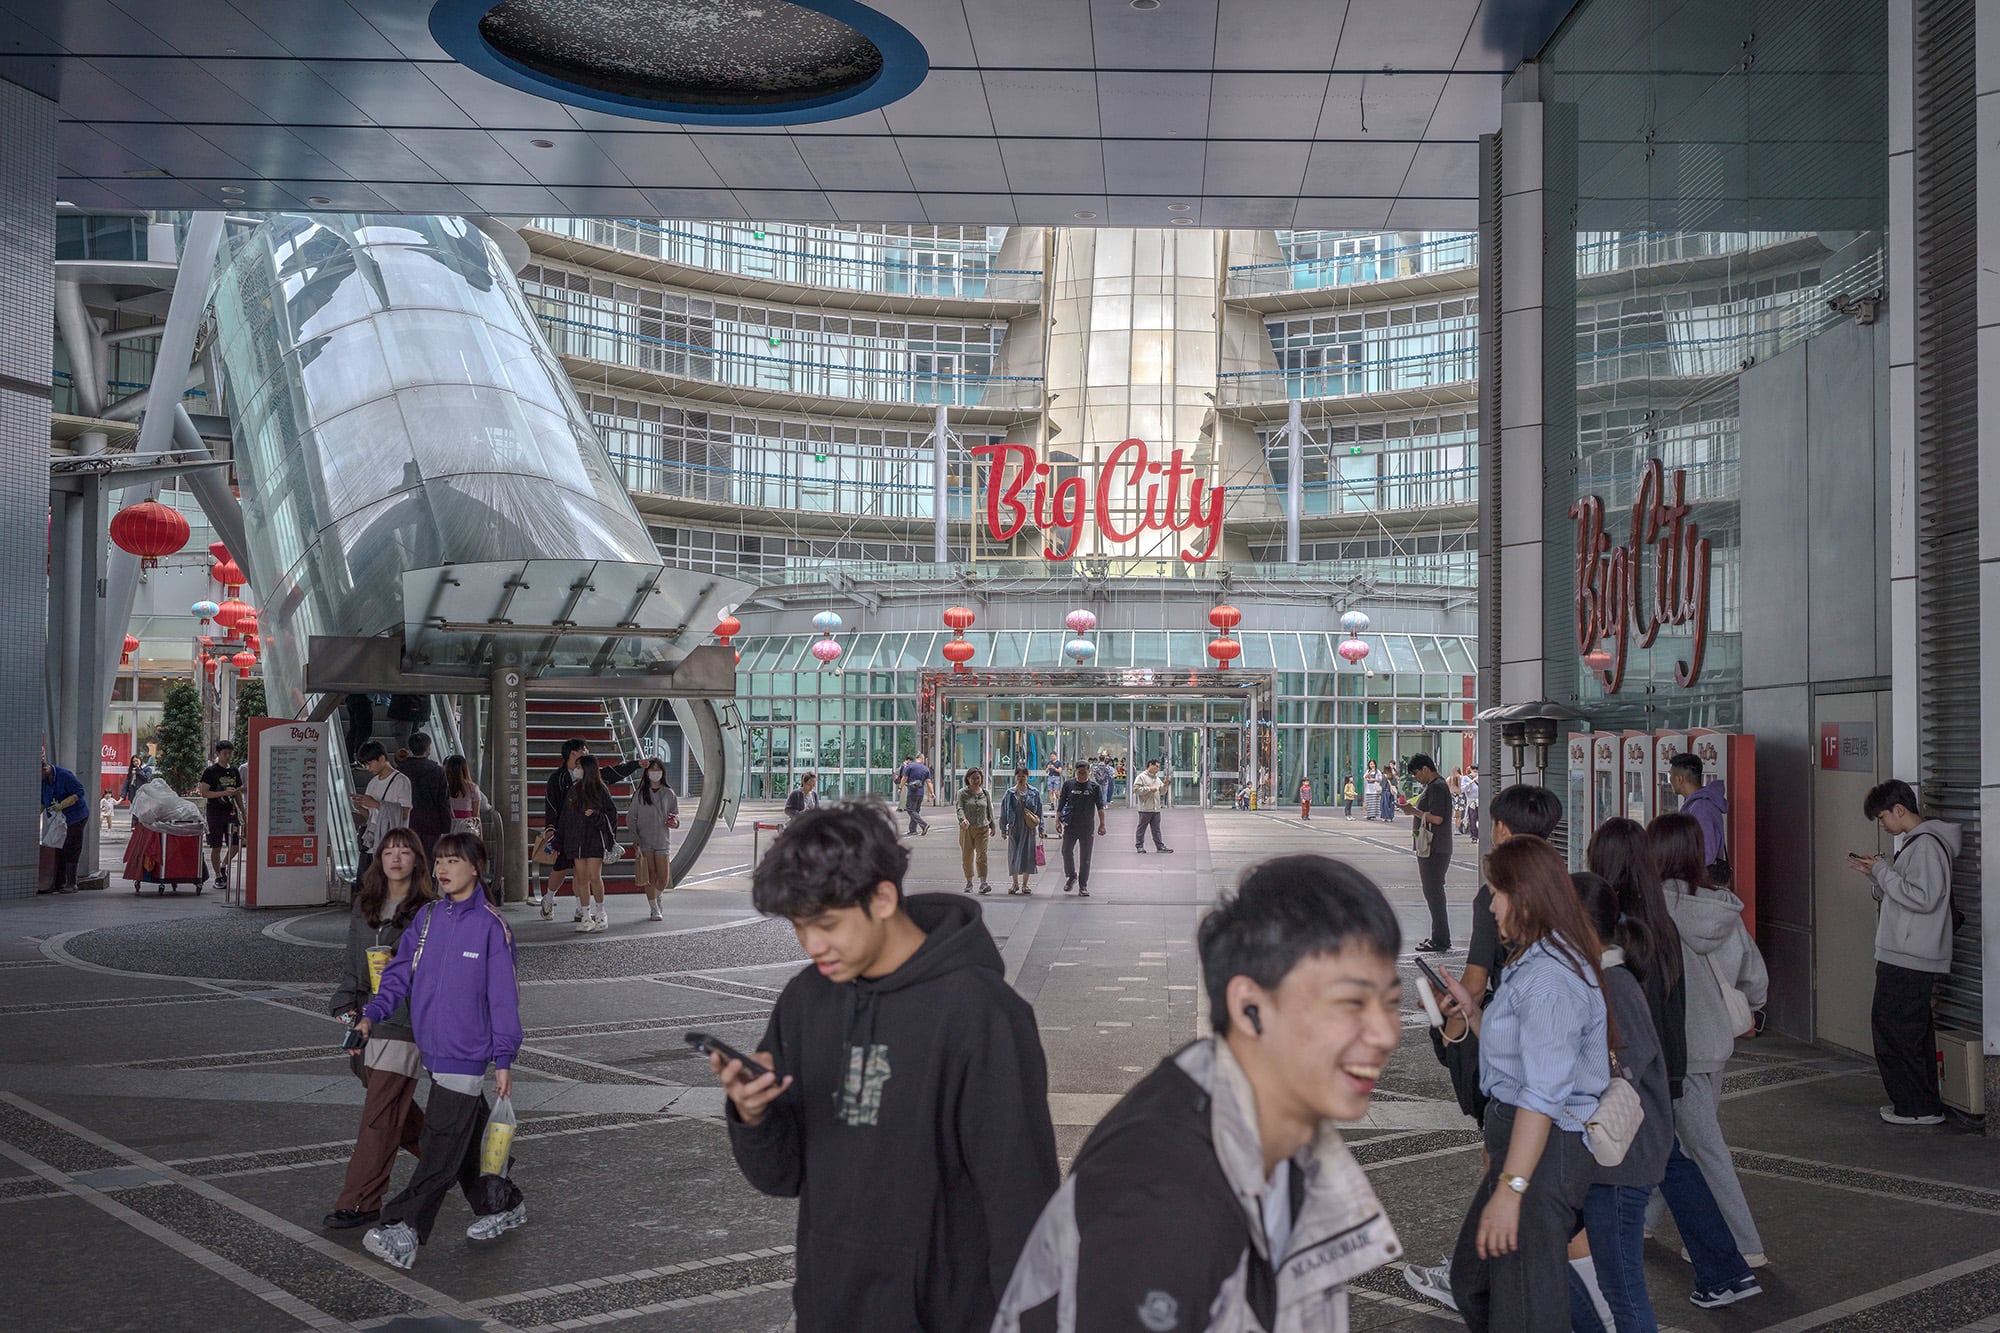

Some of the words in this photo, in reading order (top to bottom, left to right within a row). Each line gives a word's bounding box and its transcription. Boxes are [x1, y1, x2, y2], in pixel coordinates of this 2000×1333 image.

[971, 443, 1086, 561] Big
[1096, 438, 1224, 562] City
[1568, 495, 1627, 694] Big
[1628, 458, 1709, 688] City
[290, 727, 304, 742] Big
[304, 726, 320, 742] City
[101, 744, 117, 760] City
[1825, 736, 1837, 756] 1F
